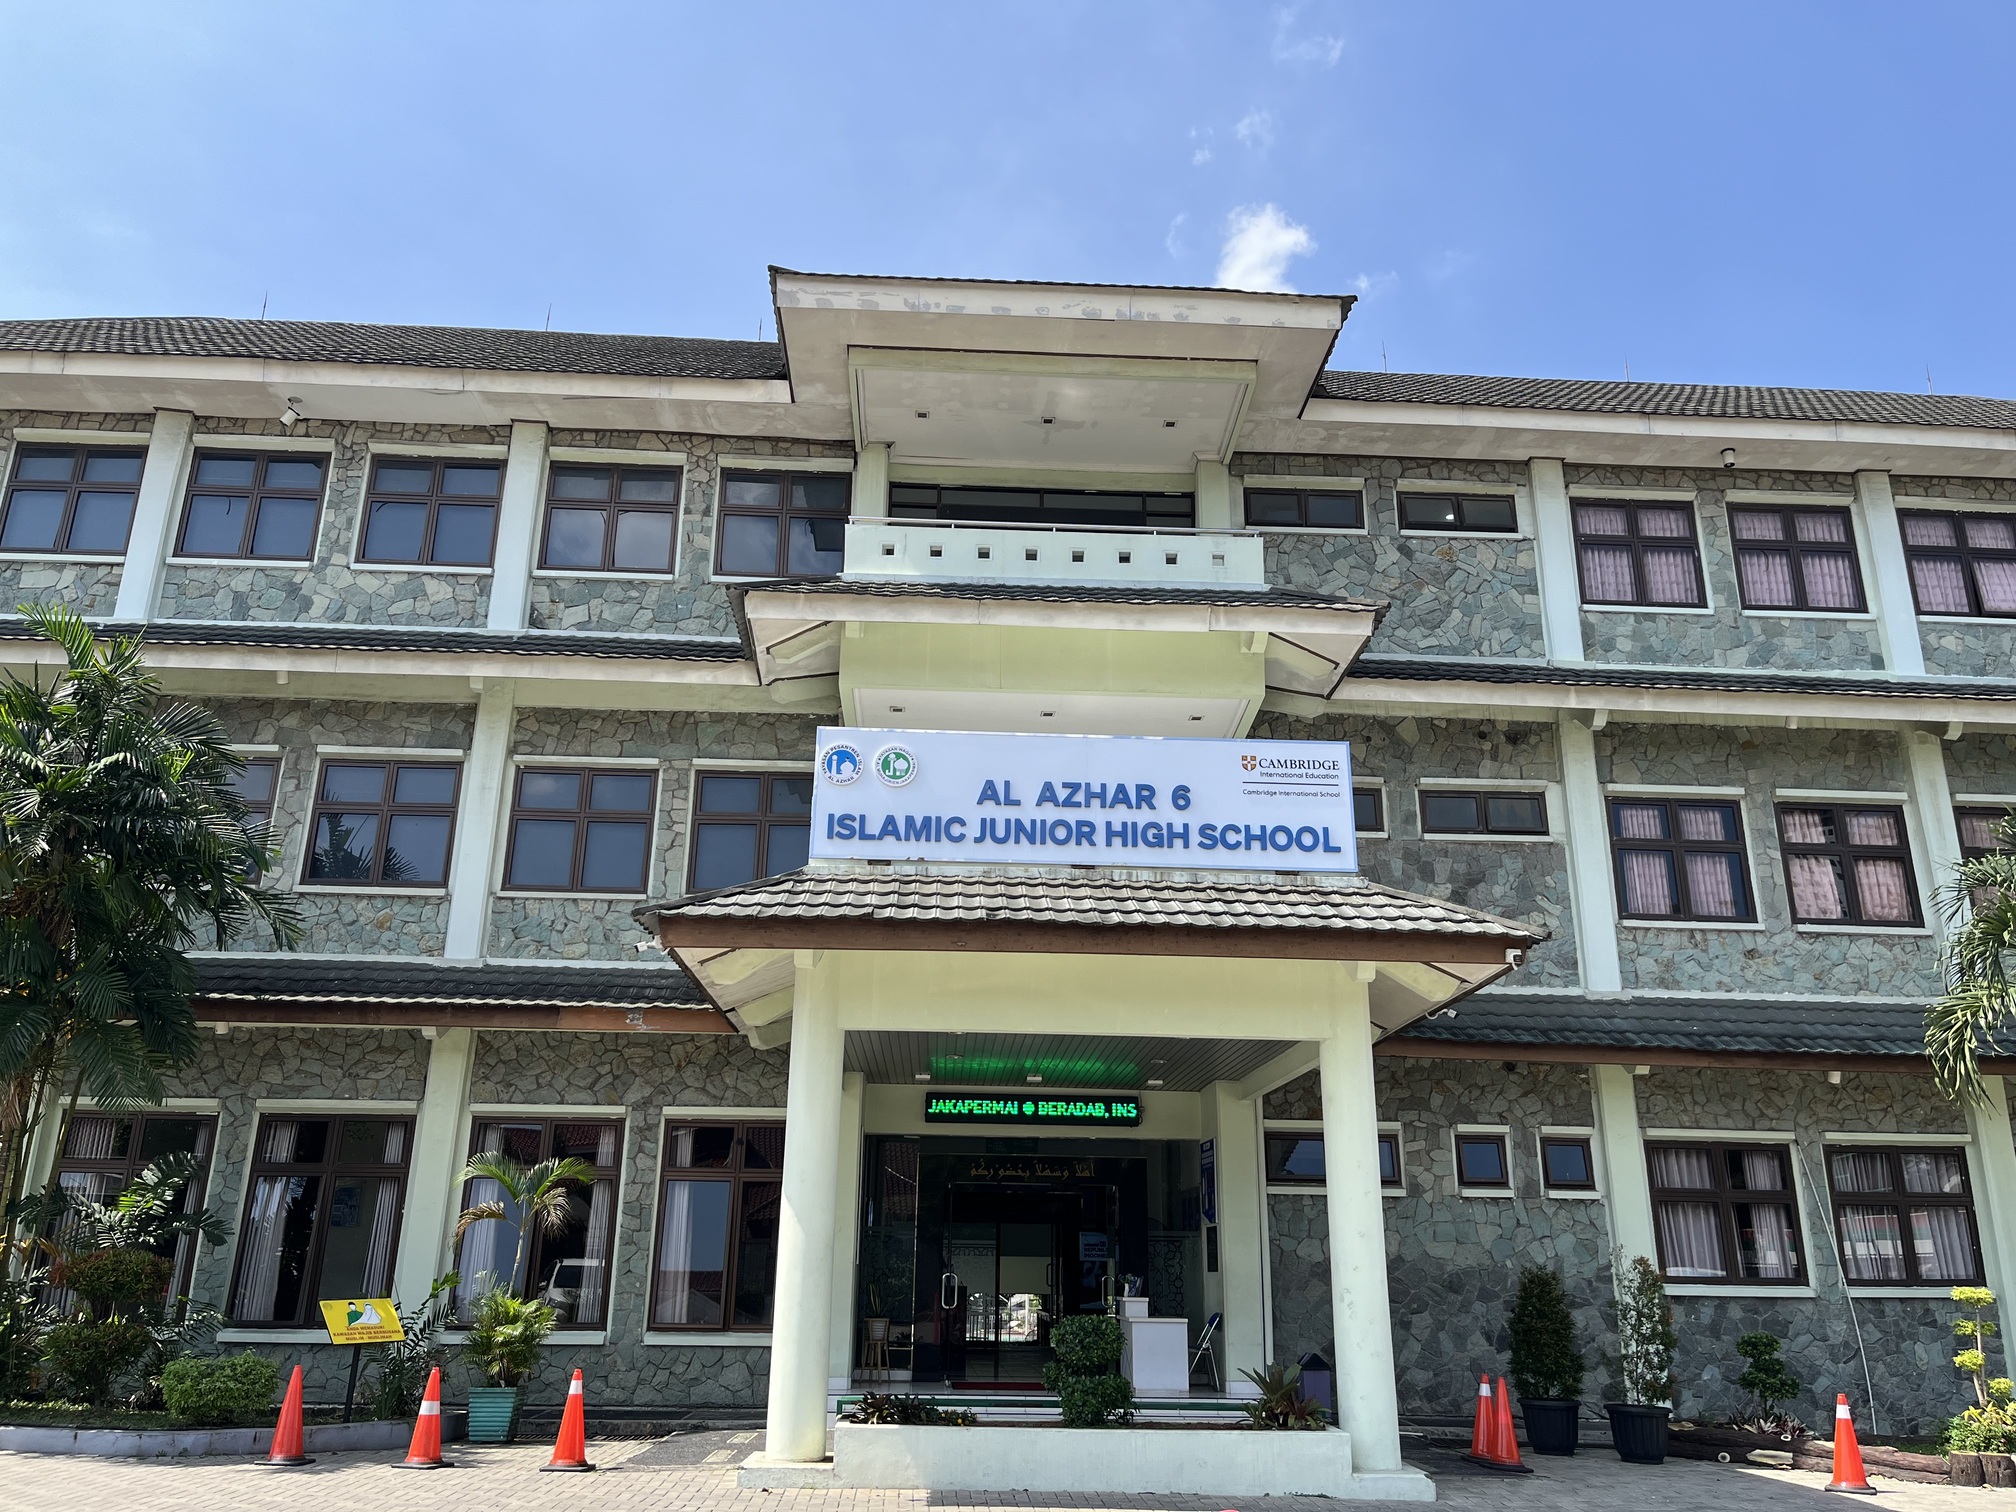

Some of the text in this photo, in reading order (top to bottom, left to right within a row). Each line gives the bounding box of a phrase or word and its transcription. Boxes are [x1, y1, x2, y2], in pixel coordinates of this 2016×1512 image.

[829, 745, 860, 757] PESANTREN
[1259, 758, 1340, 771] CAMBRIDGE
[1260, 771, 1339, 780] International Education
[976, 779, 1191, 811] AL AZHAR 6
[1242, 789, 1277, 797] Cambridge
[827, 813, 1342, 853] ISLAMIC JUNIOR HIGH SCHOOL
[928, 1099, 1137, 1119] JAKAPERMAI BERADAB, INS
